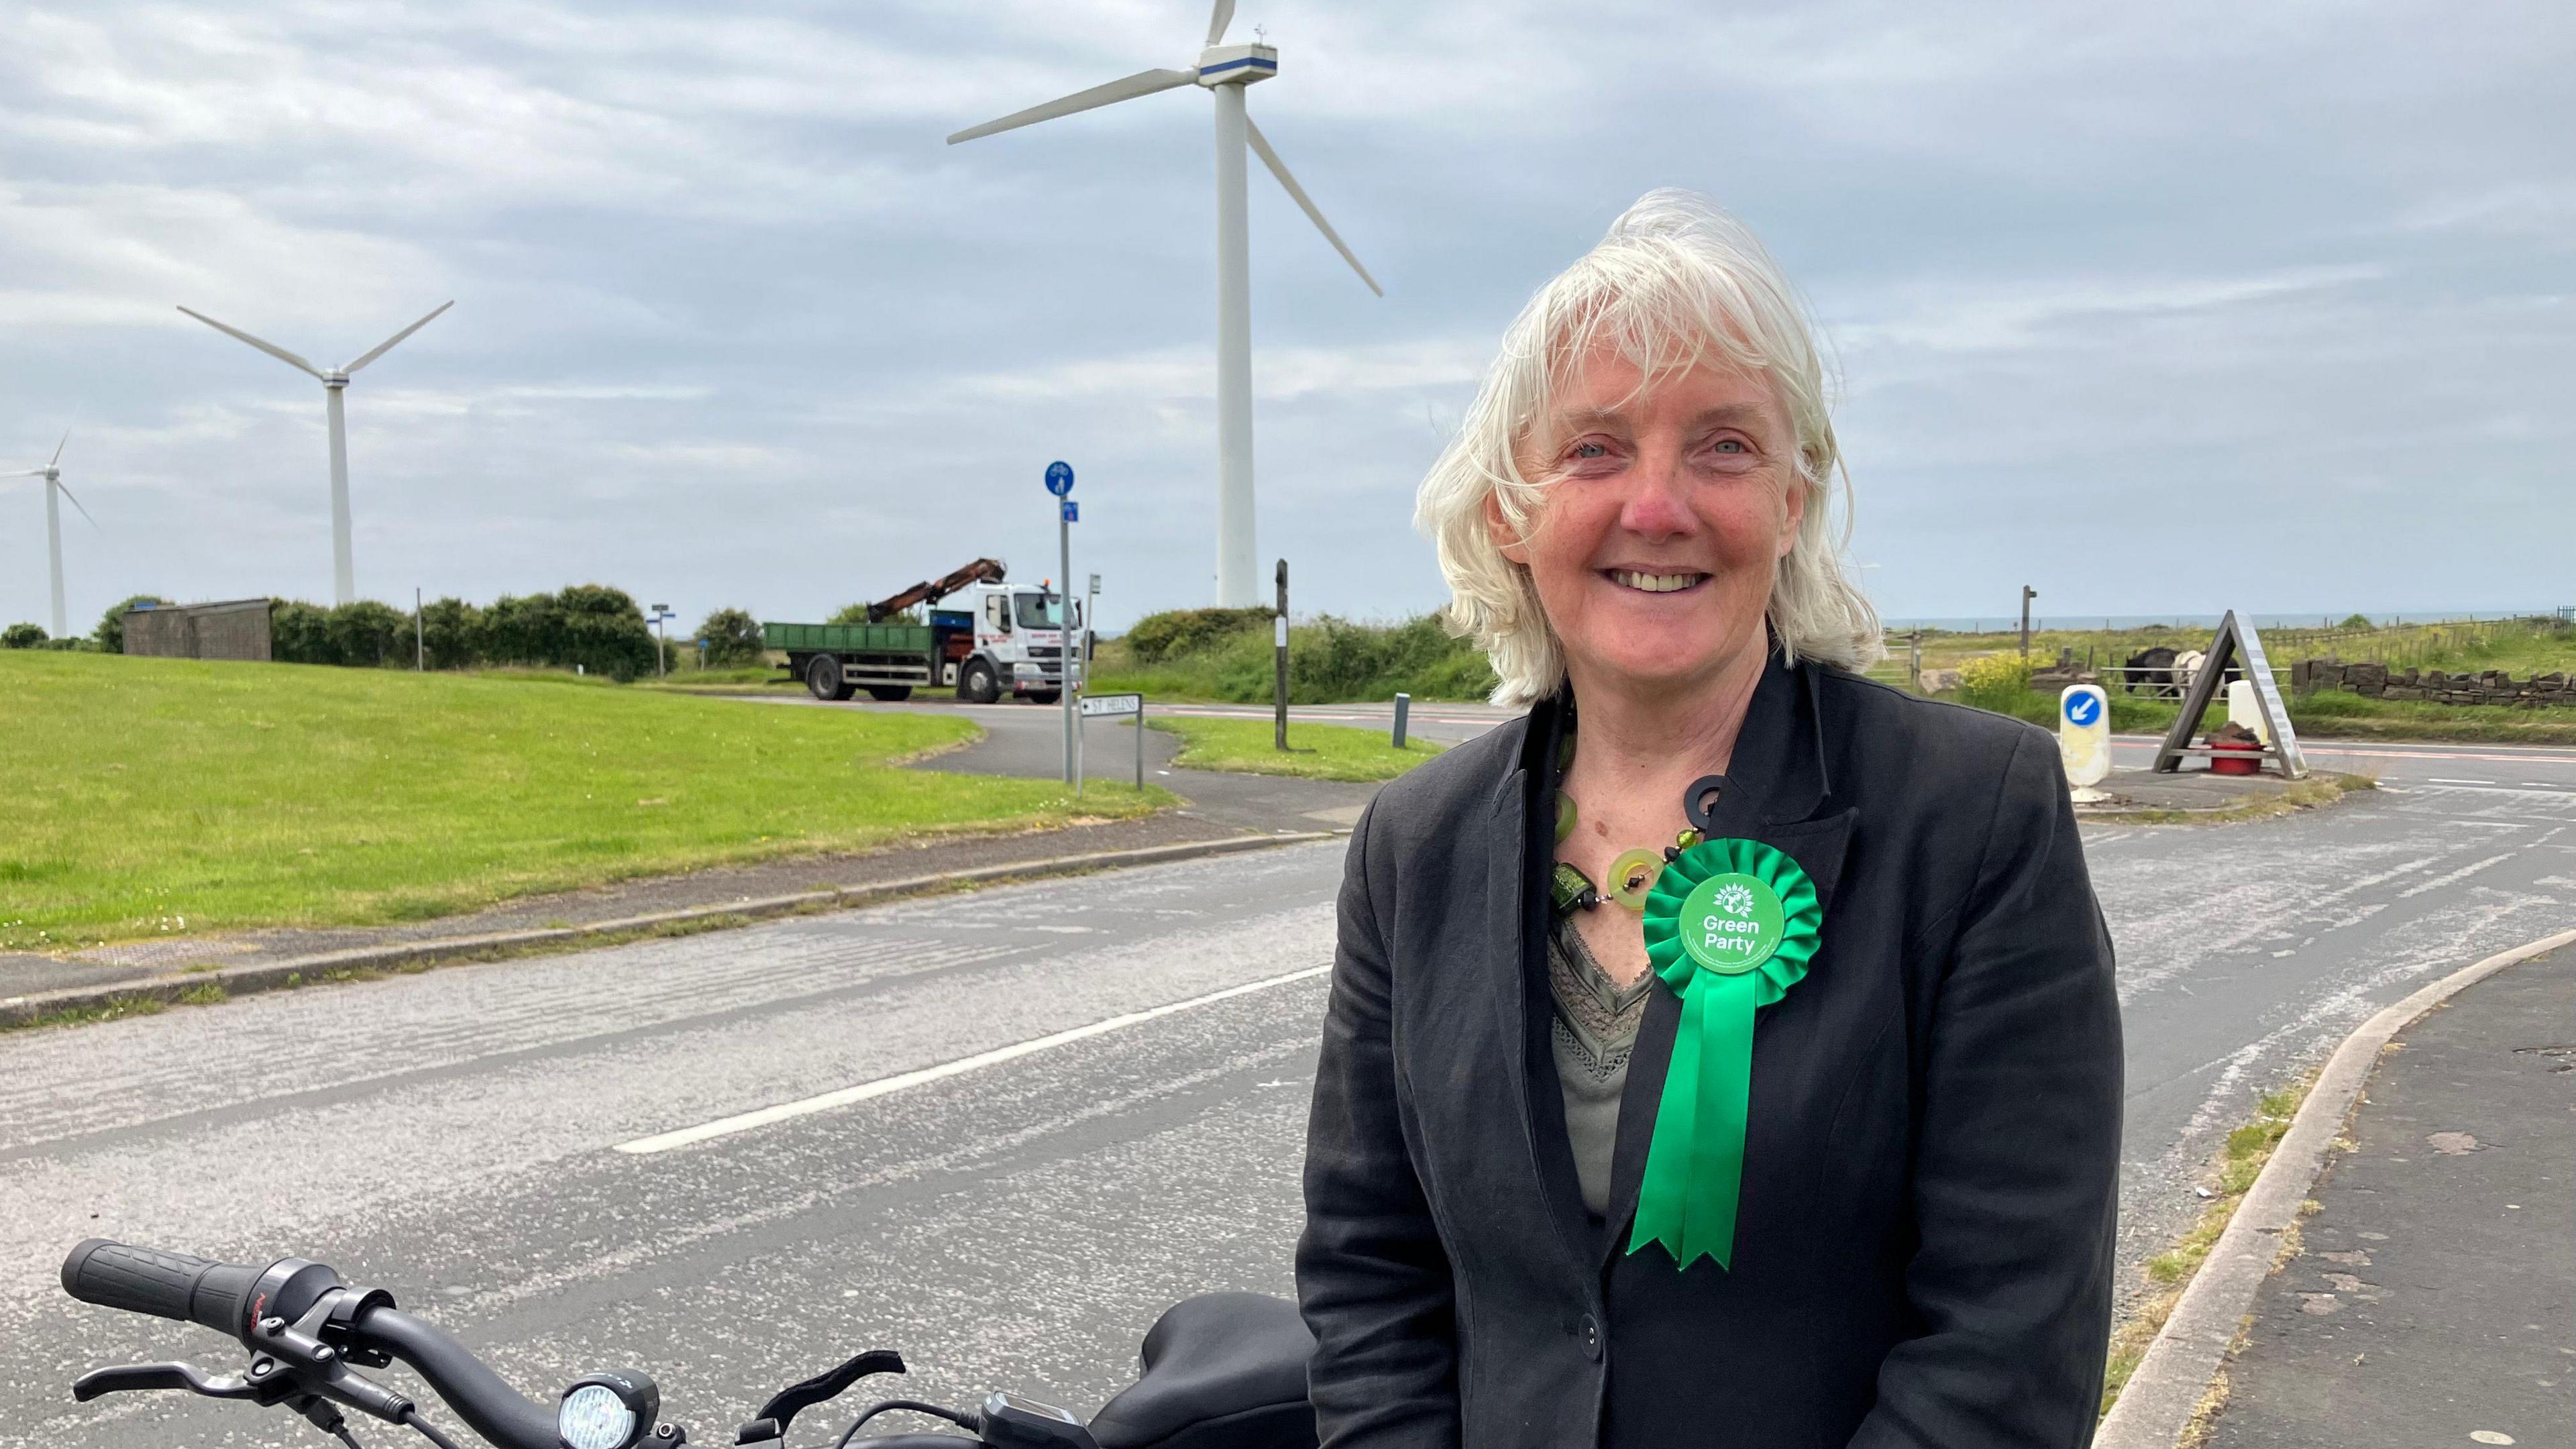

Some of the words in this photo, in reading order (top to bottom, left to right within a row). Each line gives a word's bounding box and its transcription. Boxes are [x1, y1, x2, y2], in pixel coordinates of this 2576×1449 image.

[1093, 699, 1102, 712] ST
[1107, 697, 1136, 711] HELENS
[1703, 915, 1759, 934] Green
[1704, 932, 1756, 955] Party
